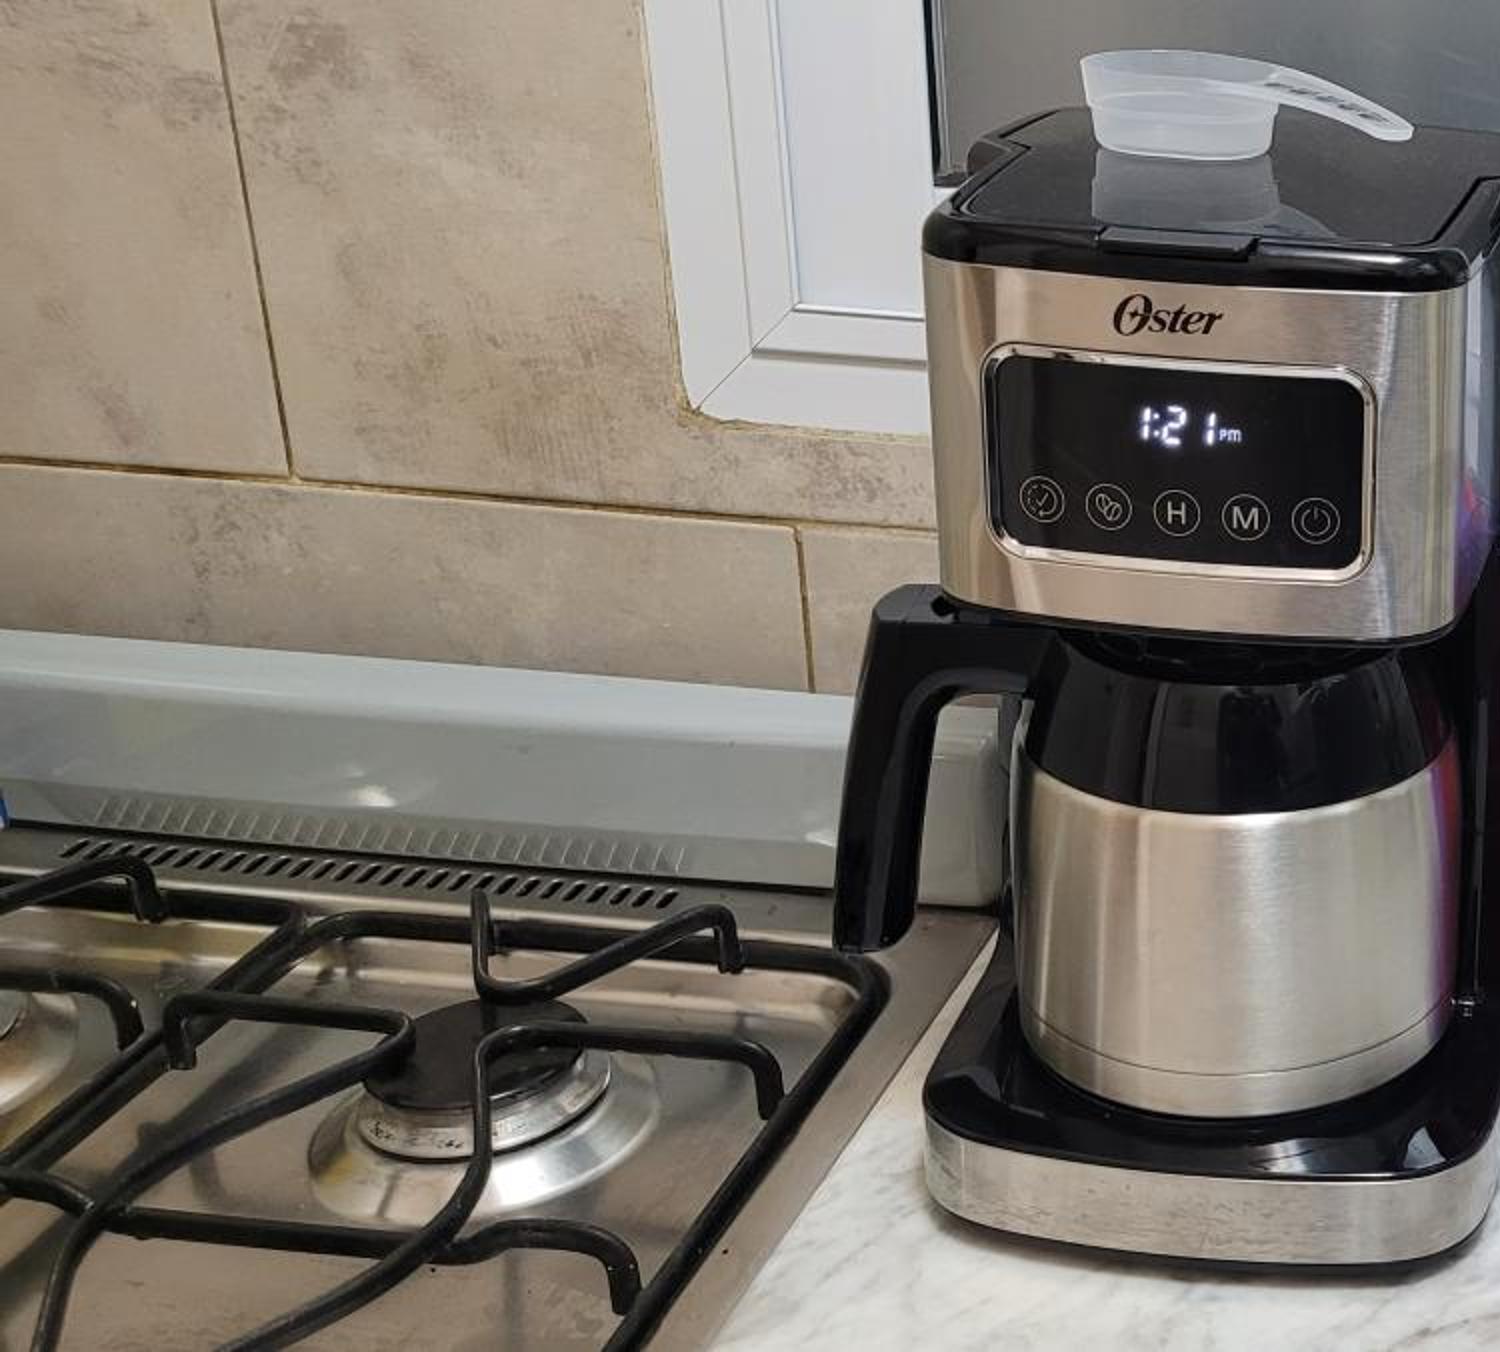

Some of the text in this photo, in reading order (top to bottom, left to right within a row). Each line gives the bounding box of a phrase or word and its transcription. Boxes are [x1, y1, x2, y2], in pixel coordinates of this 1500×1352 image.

[1113, 293, 1224, 336] Oster
[1140, 404, 1217, 446] 1:21
[1167, 500, 1187, 525] H
[1232, 505, 1259, 531] M
